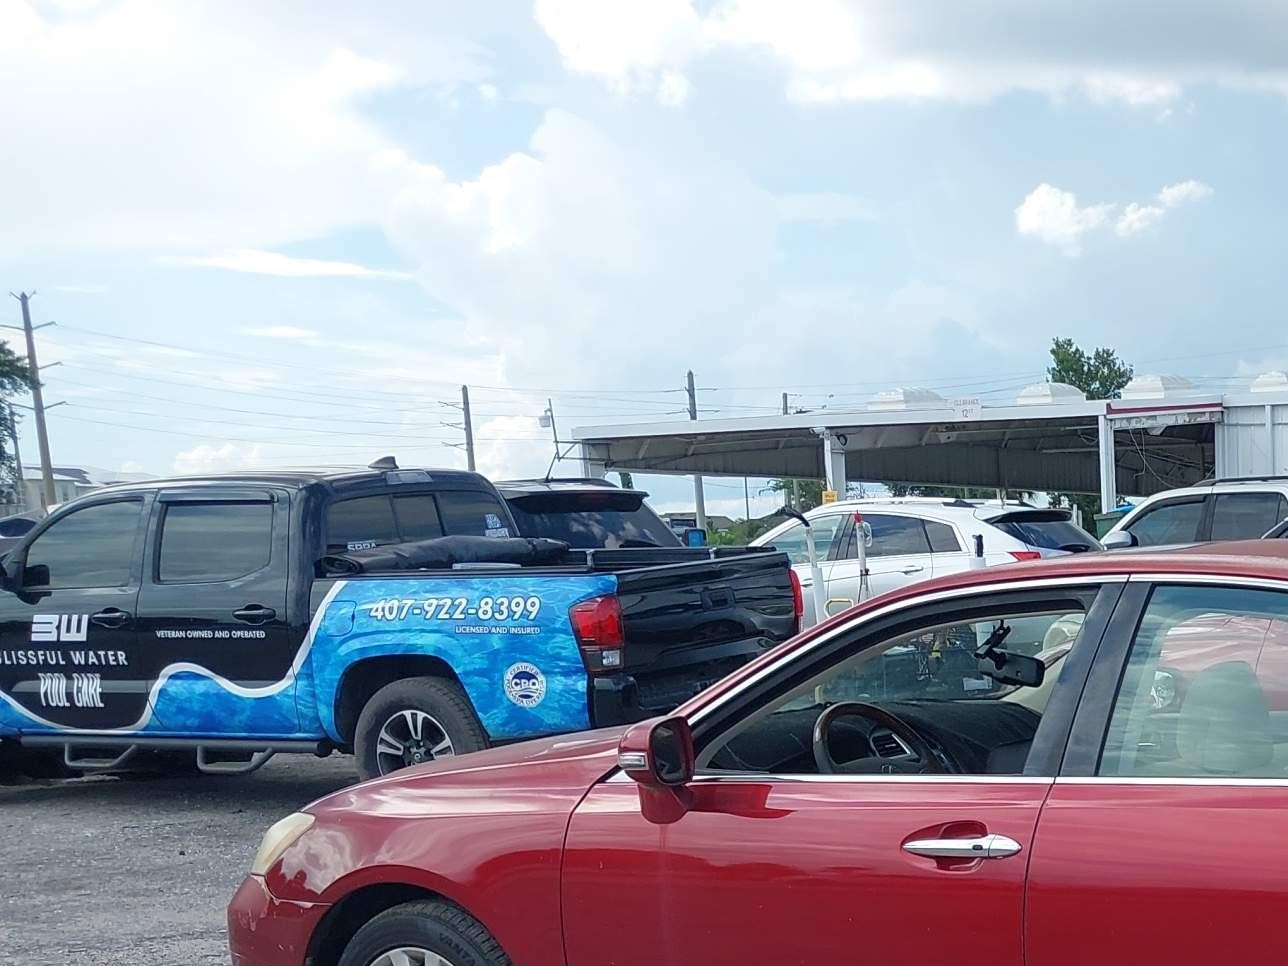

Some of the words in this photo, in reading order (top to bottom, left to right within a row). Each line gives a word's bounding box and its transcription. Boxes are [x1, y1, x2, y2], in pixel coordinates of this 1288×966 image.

[369, 596, 541, 621] 407-922-8399
[155, 630, 186, 639] VETERAN
[186, 630, 213, 639] OWNED
[214, 630, 230, 639] AND
[231, 630, 266, 639] OPERATED
[455, 626, 490, 634] LICENSED
[491, 626, 508, 634] AND
[509, 626, 541, 634] INSURED
[70, 650, 128, 666] WATER
[37, 672, 71, 707] POOL
[72, 673, 105, 708] CARE
